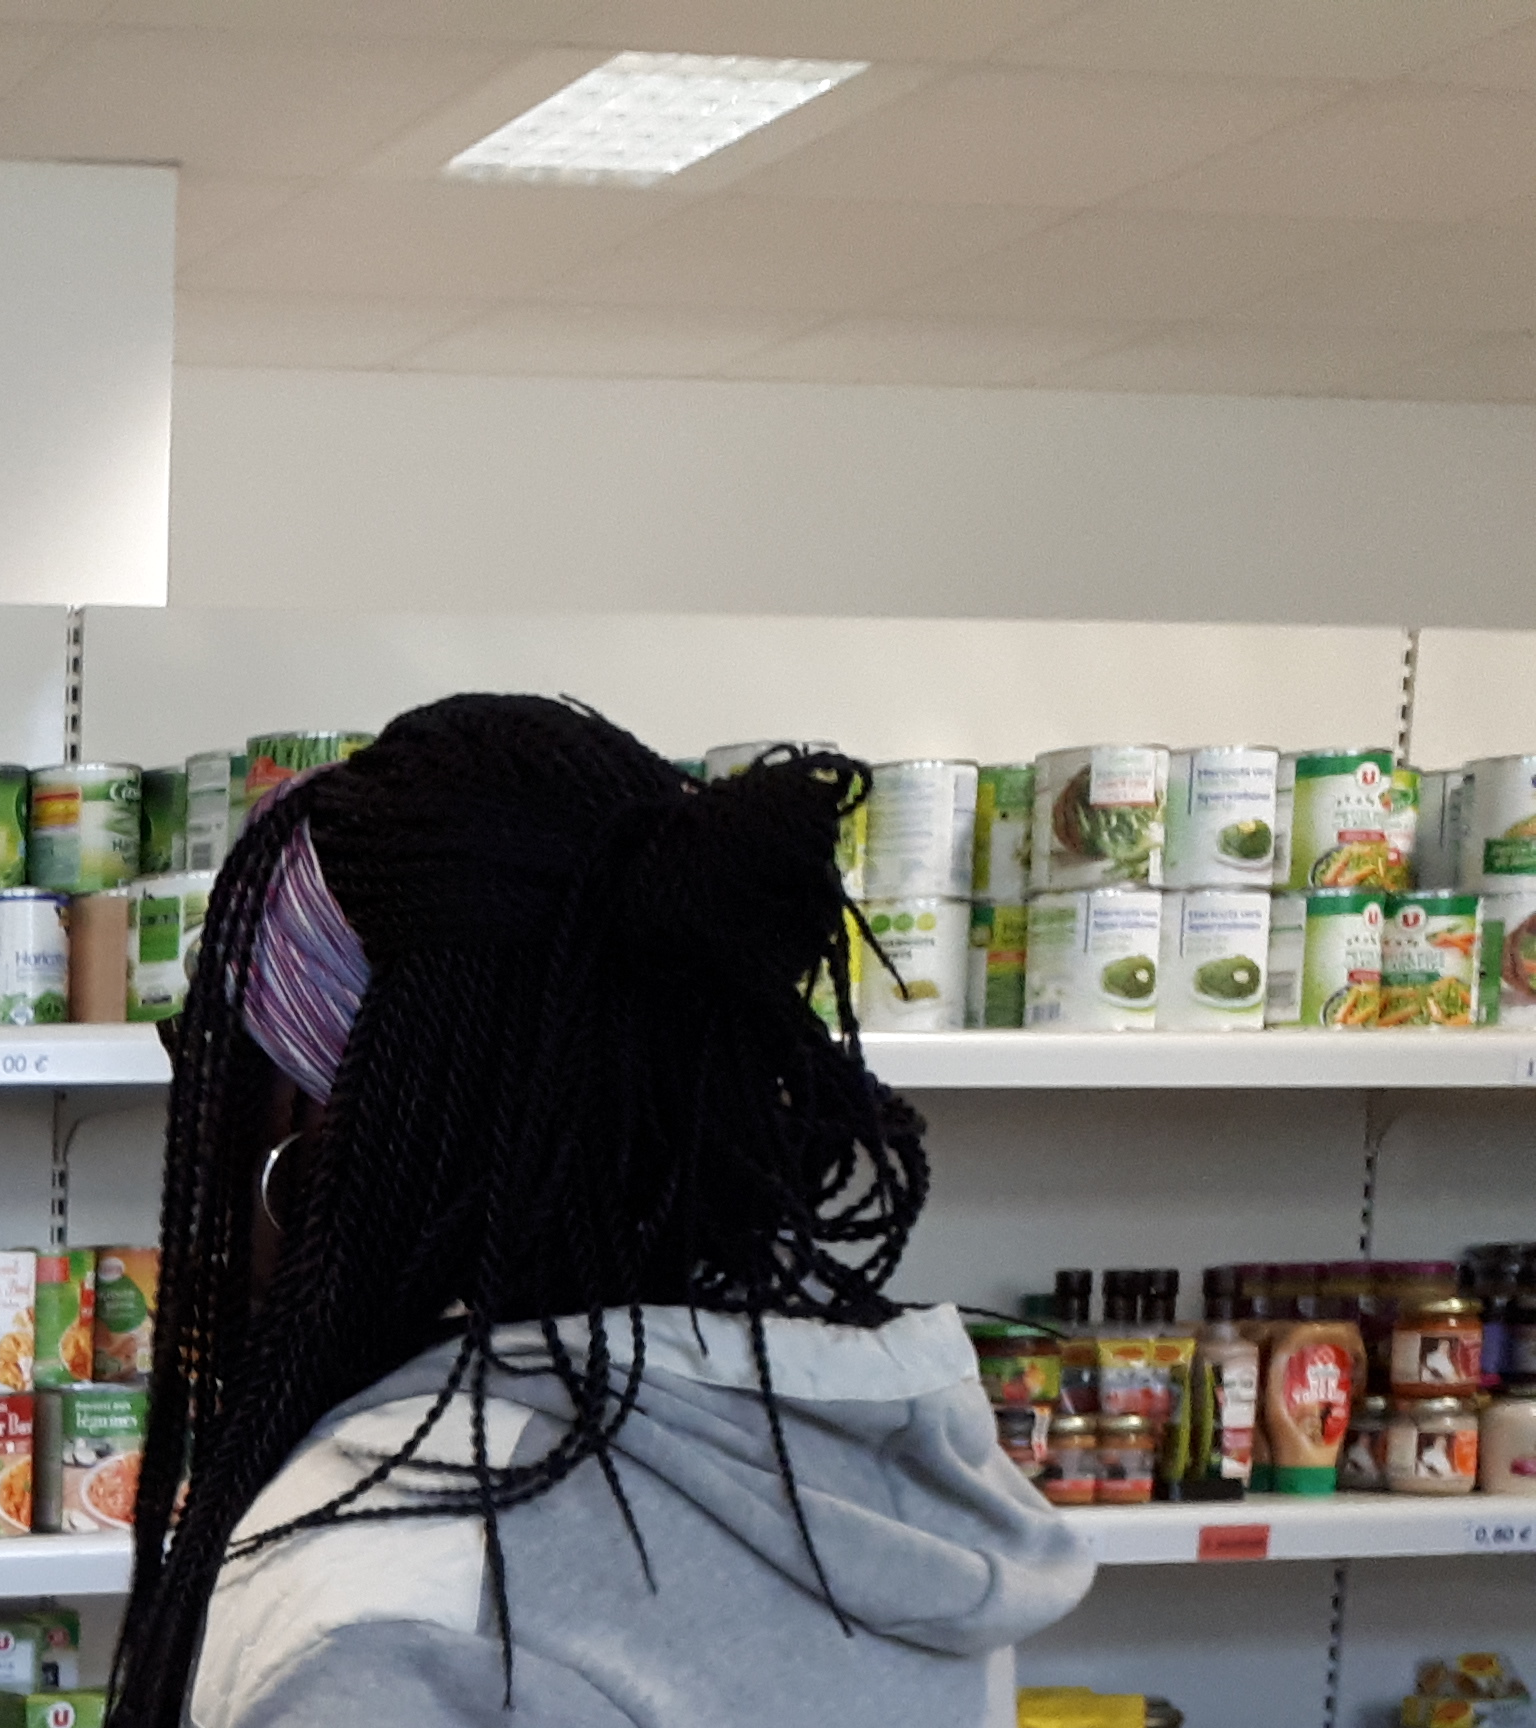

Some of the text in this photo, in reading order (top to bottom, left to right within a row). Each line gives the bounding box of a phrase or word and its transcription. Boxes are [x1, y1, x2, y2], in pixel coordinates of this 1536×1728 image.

[1361, 770, 1376, 785] U
[1402, 911, 1421, 927] U
[34, 1055, 49, 1073] €
[52, 1709, 69, 1727] U
